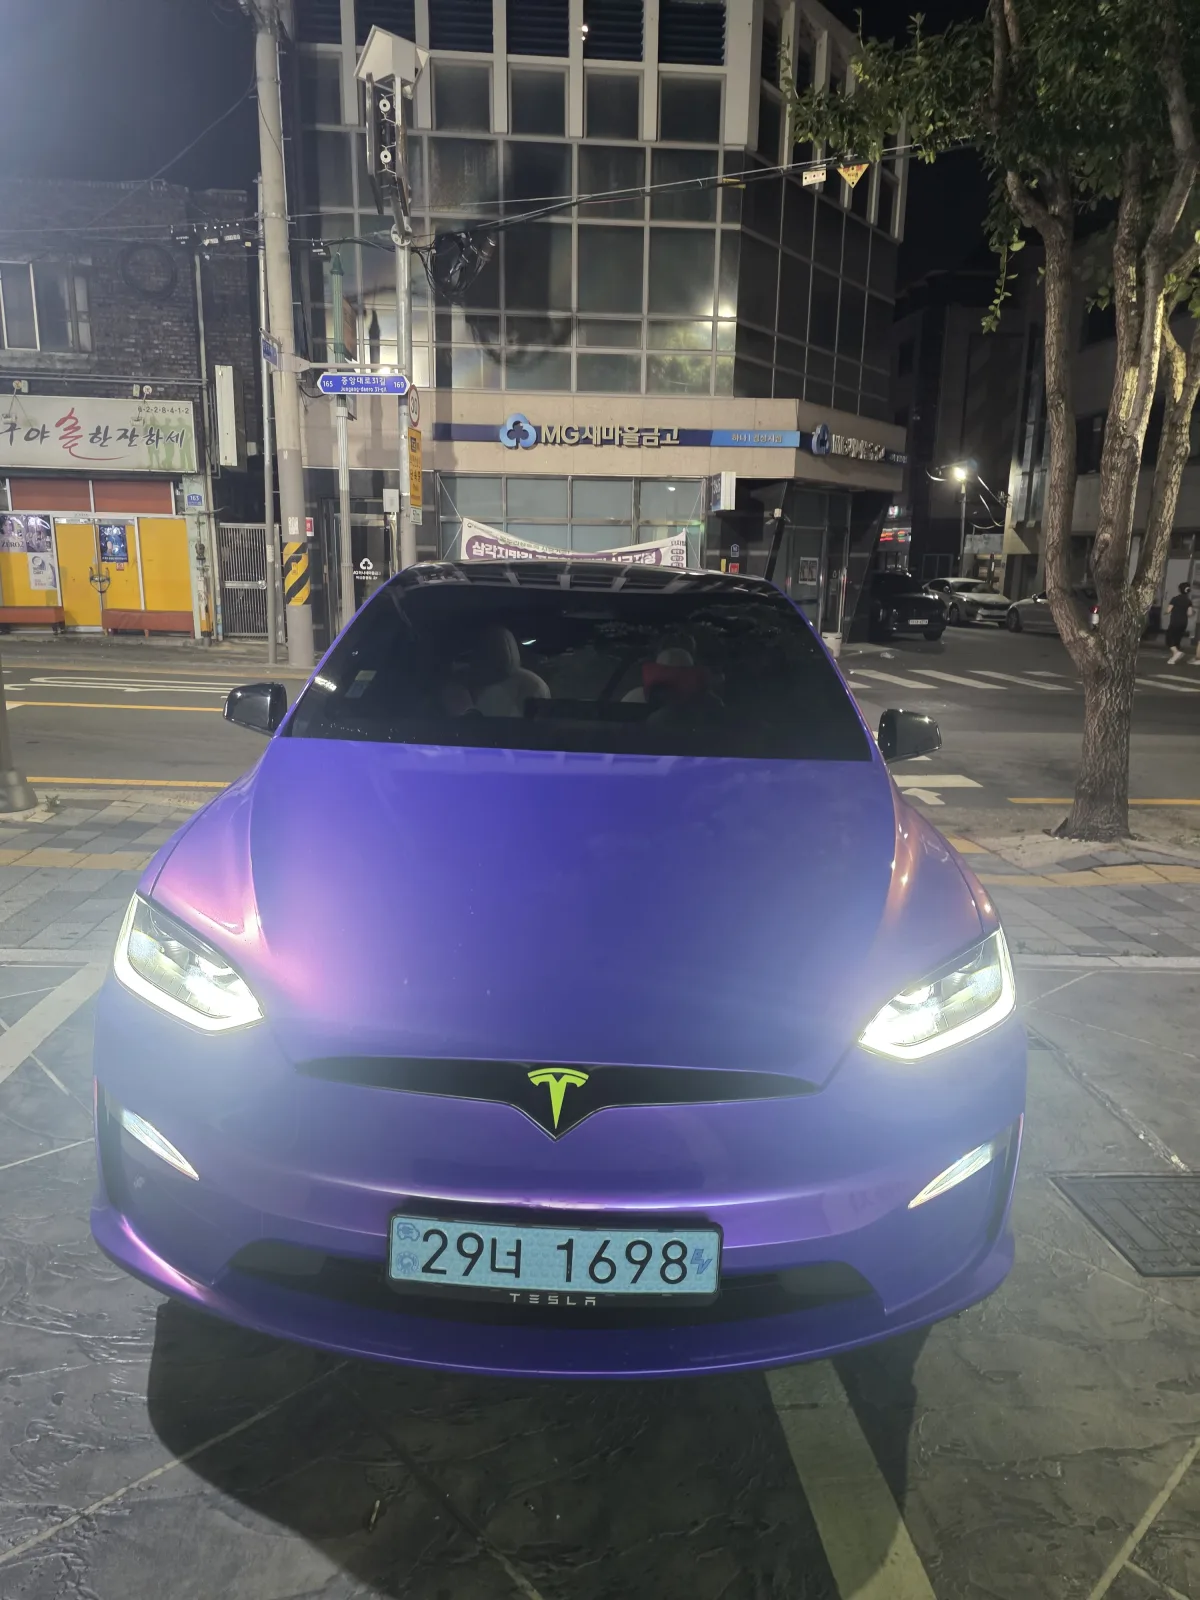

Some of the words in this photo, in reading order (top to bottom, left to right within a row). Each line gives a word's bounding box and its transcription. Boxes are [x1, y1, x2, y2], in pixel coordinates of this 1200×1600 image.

[323, 380, 333, 388] 165
[341, 376, 386, 386] 중앙대로31길
[394, 381, 404, 389] 169
[540, 423, 680, 446] MG새마을금고
[421, 1228, 522, 1278] 29너
[556, 1238, 688, 1285] 1698
[509, 1293, 597, 1306] TESLA
